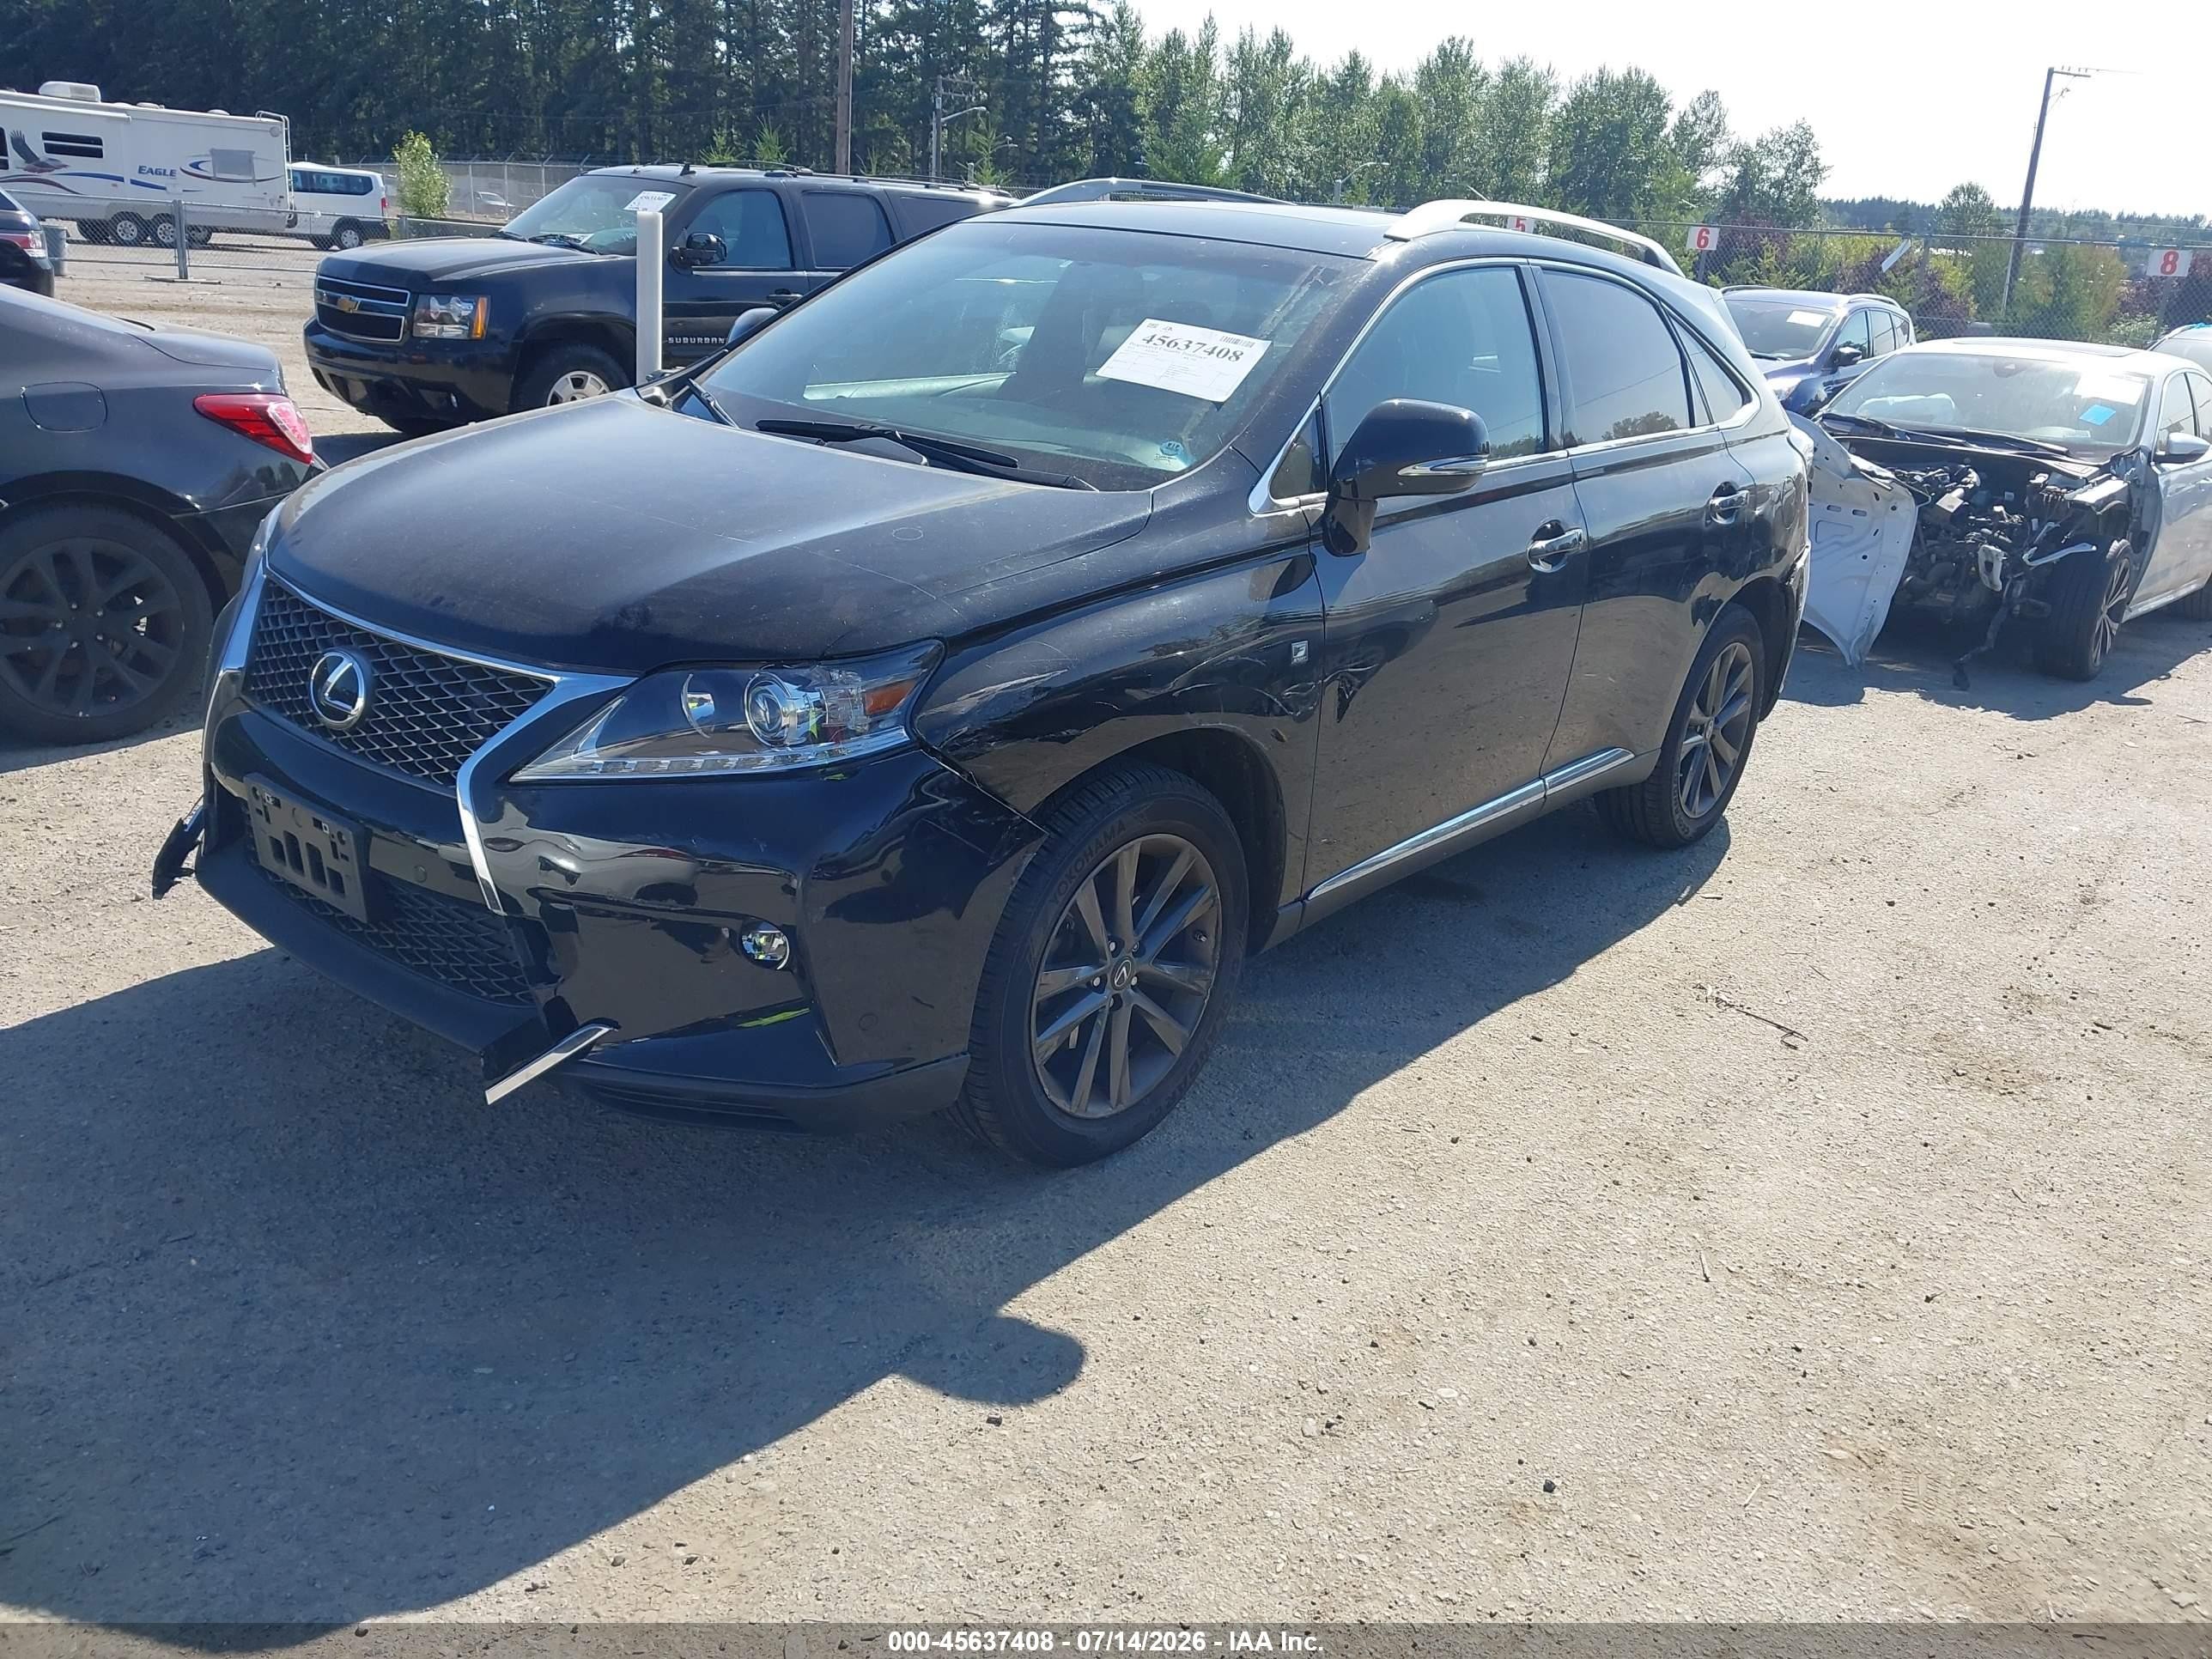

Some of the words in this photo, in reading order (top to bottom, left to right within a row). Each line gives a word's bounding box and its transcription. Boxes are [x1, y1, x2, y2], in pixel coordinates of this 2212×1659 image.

[138, 165, 177, 177] EAGLE
[1516, 217, 1526, 232] 5
[1697, 228, 1710, 248] 6
[2160, 251, 2179, 275] 8
[1142, 333, 1244, 362] 45637408
[1048, 817, 1126, 908] YOKOHAMA
